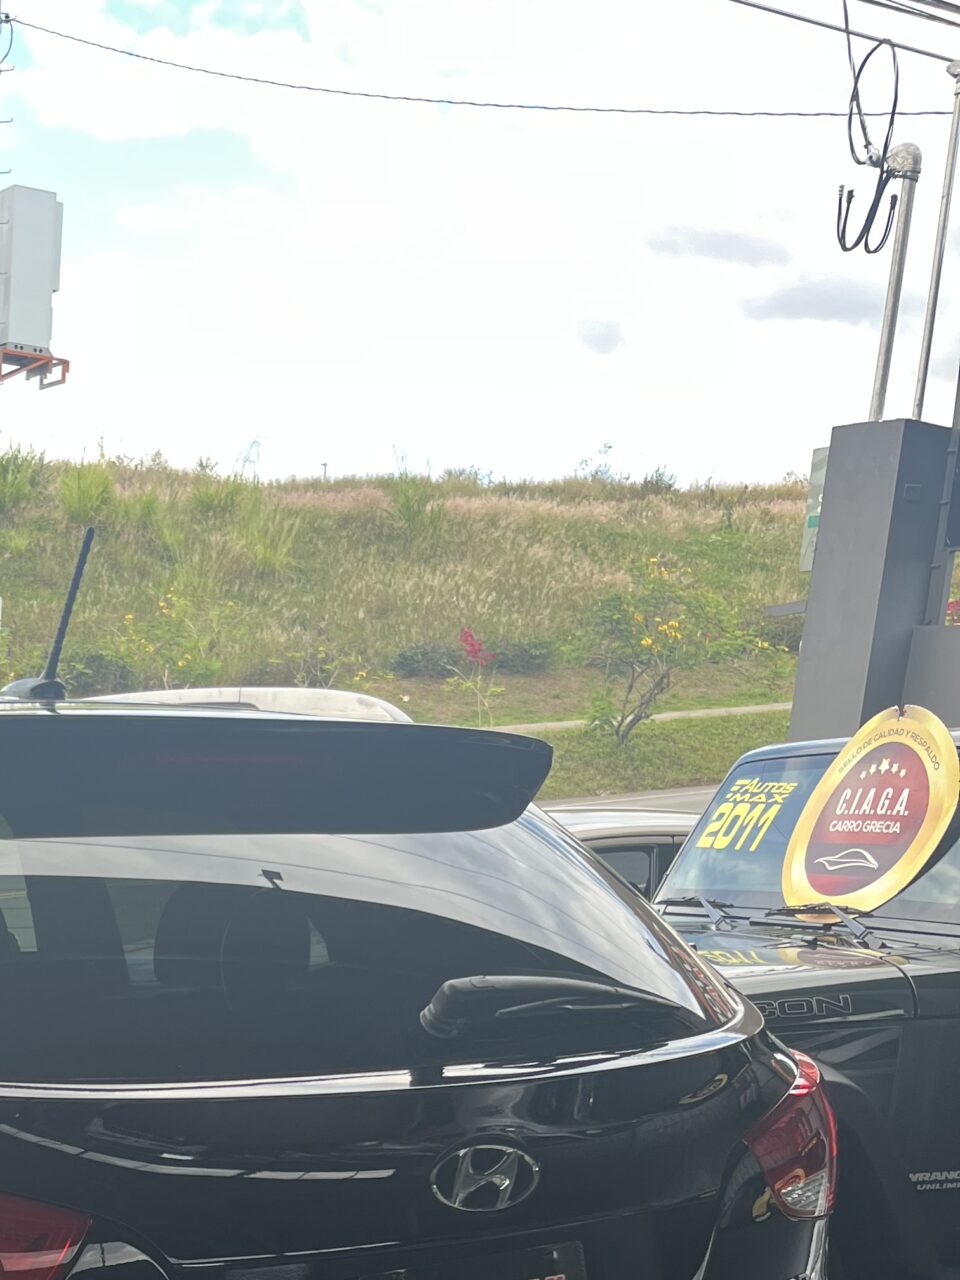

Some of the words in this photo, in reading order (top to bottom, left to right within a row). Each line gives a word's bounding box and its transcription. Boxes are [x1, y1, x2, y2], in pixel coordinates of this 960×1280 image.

[862, 737, 874, 750] DE
[873, 728, 905, 743] CALIDAD
[910, 731, 940, 771] RESPALDO
[739, 777, 798, 794] AUTOS
[728, 792, 790, 803] MAX
[835, 787, 909, 816] C.I.A.G.A.
[696, 802, 782, 852] 2011
[829, 820, 863, 833] CARRO
[862, 820, 901, 834] GRECIA
